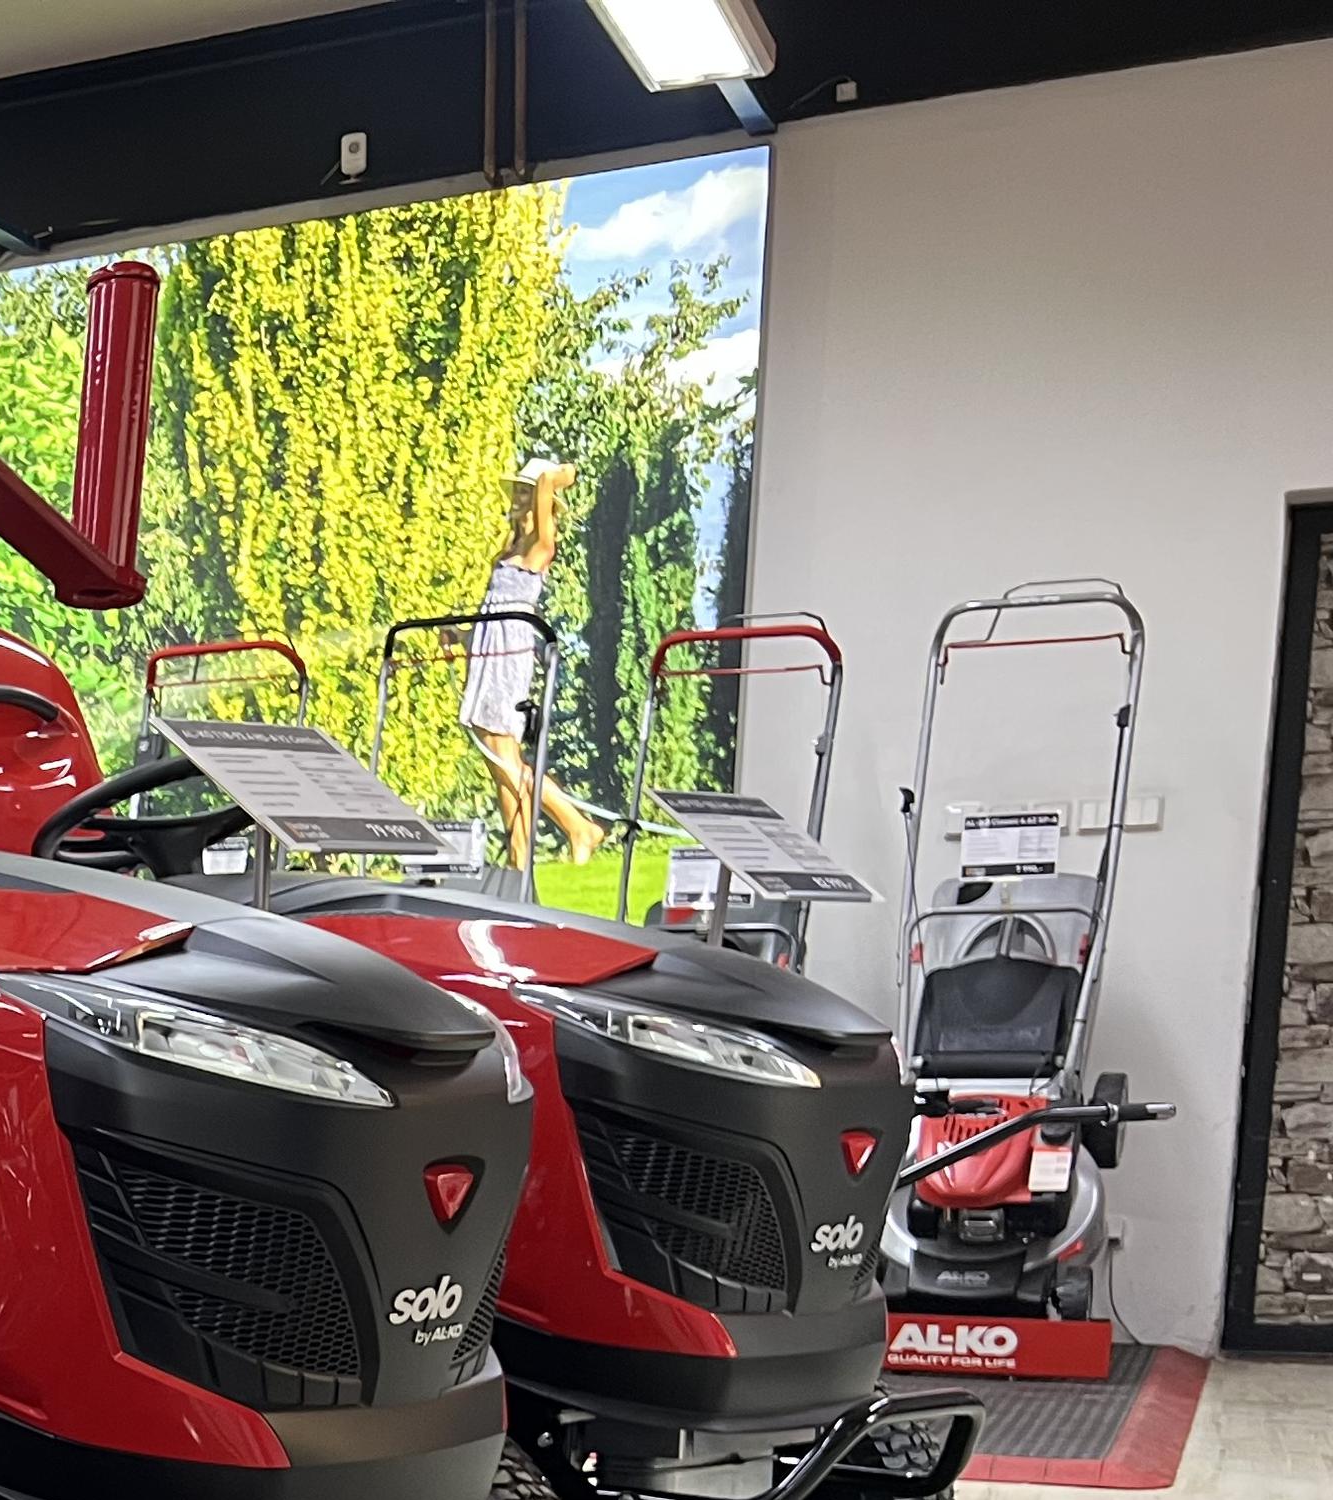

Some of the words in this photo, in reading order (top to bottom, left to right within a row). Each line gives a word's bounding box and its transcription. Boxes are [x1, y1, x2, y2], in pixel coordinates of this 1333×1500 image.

[811, 1215, 864, 1252] solo
[389, 1275, 463, 1325] solo
[415, 1330, 432, 1346] by
[889, 1322, 1019, 1358] AL-KO
[887, 1354, 949, 1366] QUALITY
[951, 1356, 983, 1368] FOR
[984, 1357, 1017, 1369] LIFE
